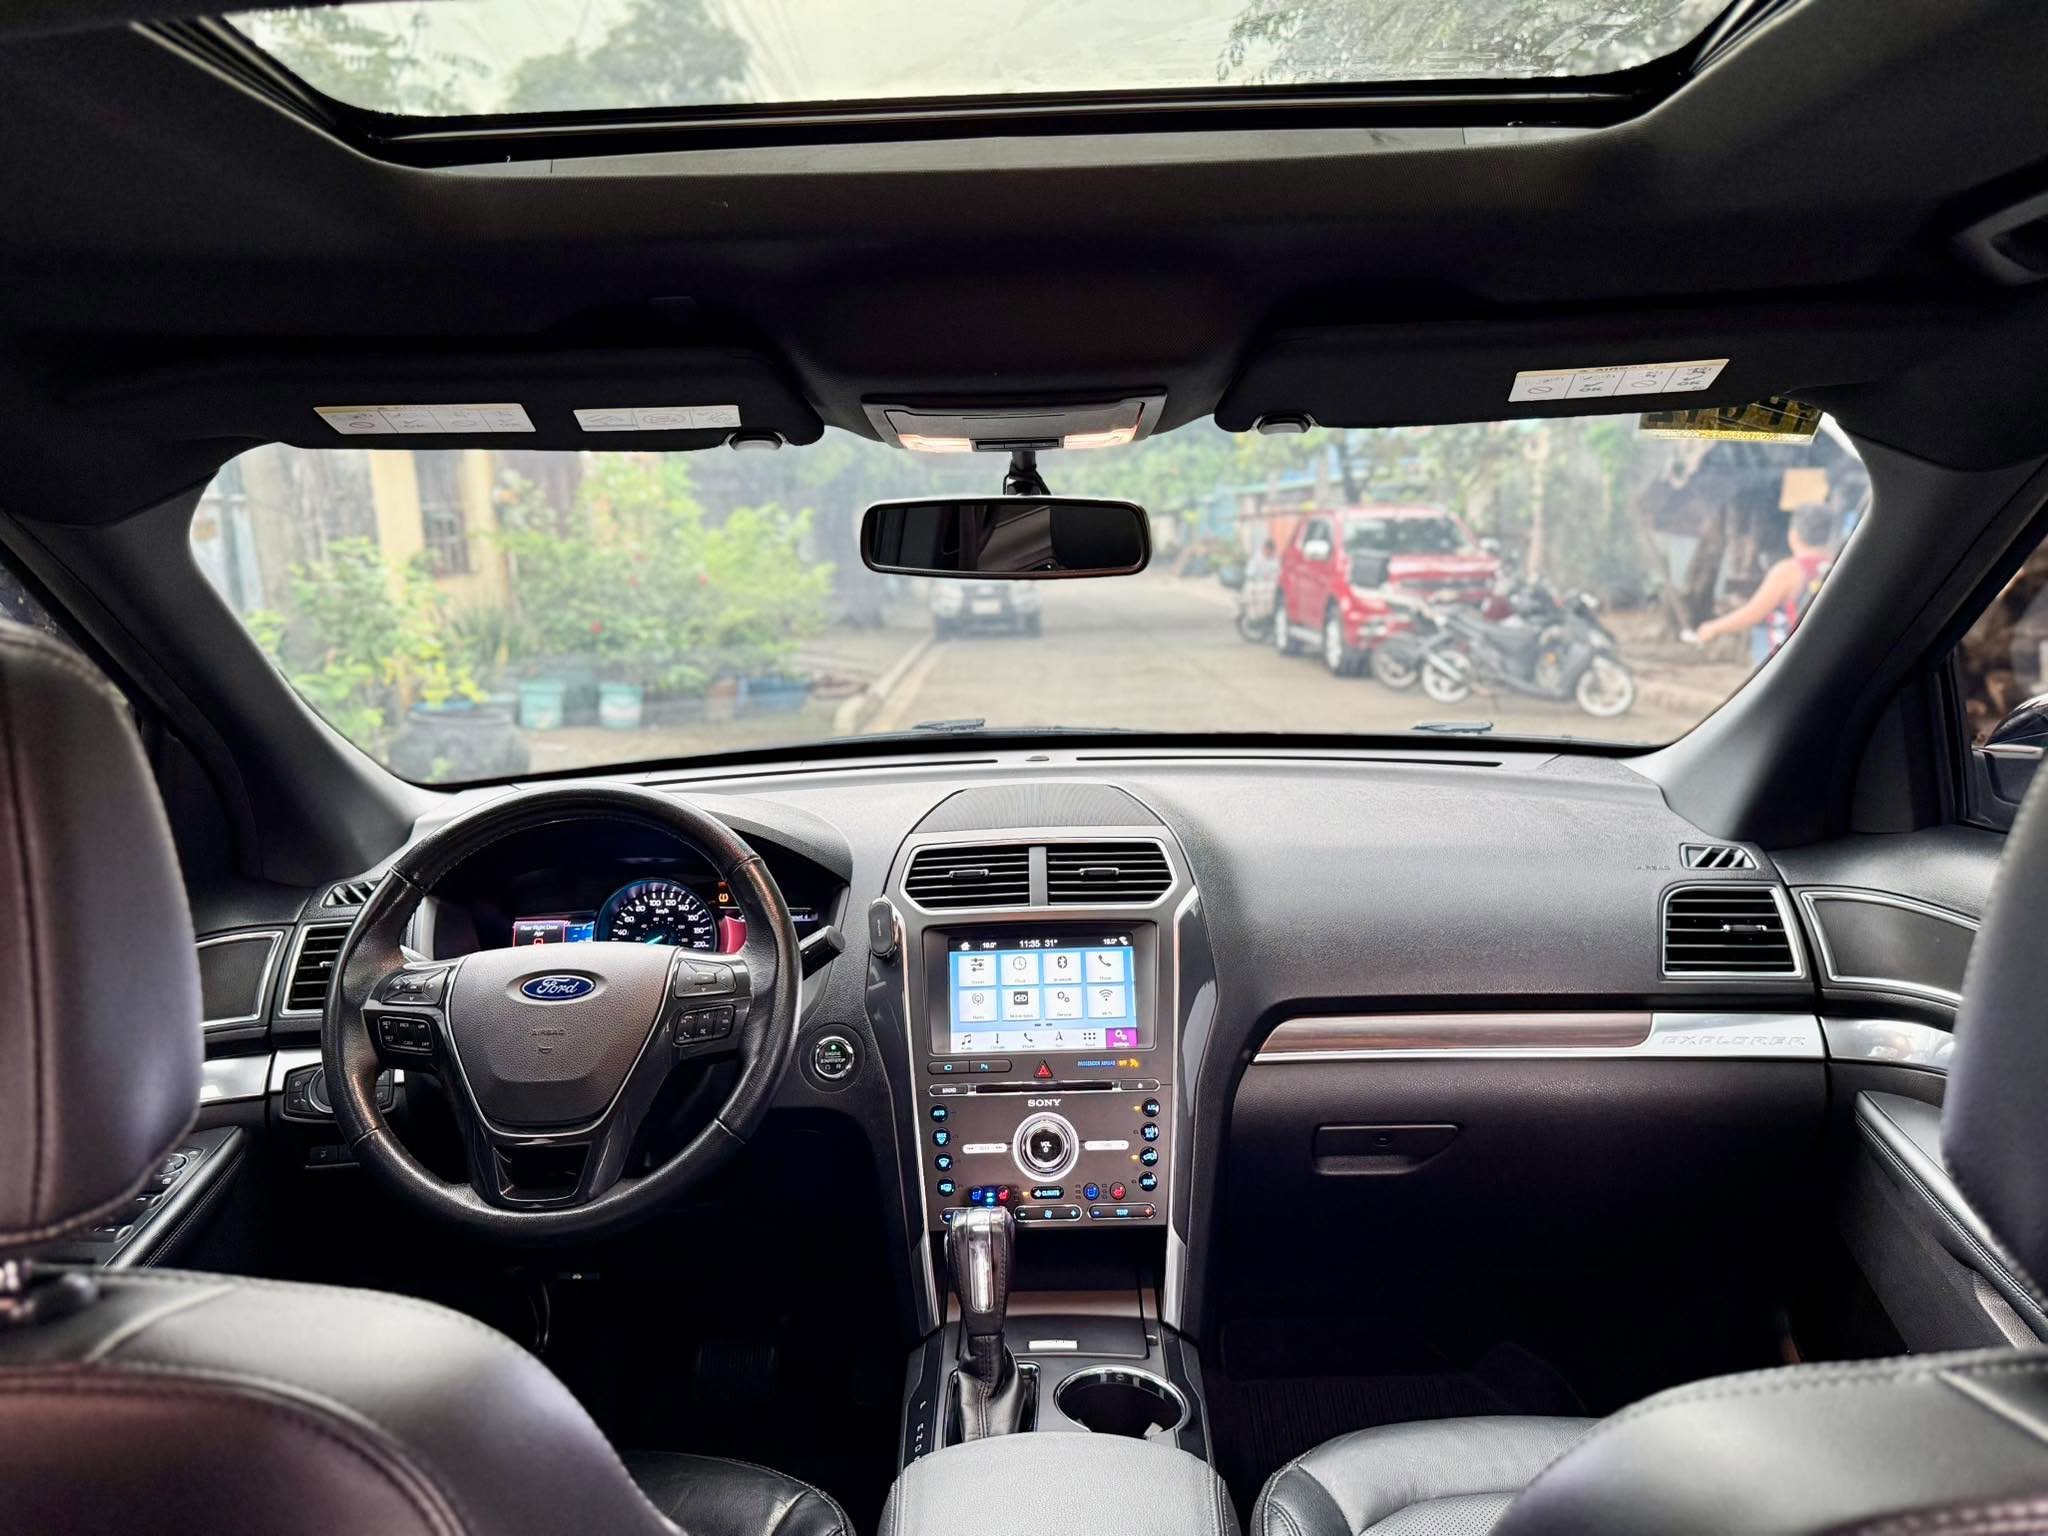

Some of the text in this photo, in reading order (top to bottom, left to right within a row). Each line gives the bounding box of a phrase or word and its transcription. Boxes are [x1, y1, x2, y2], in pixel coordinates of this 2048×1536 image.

[1019, 940, 1040, 948] 11:35
[536, 978, 580, 994] Ford
[1662, 1035, 1806, 1046] EXPLORER
[1027, 1099, 1062, 1107] SONY
